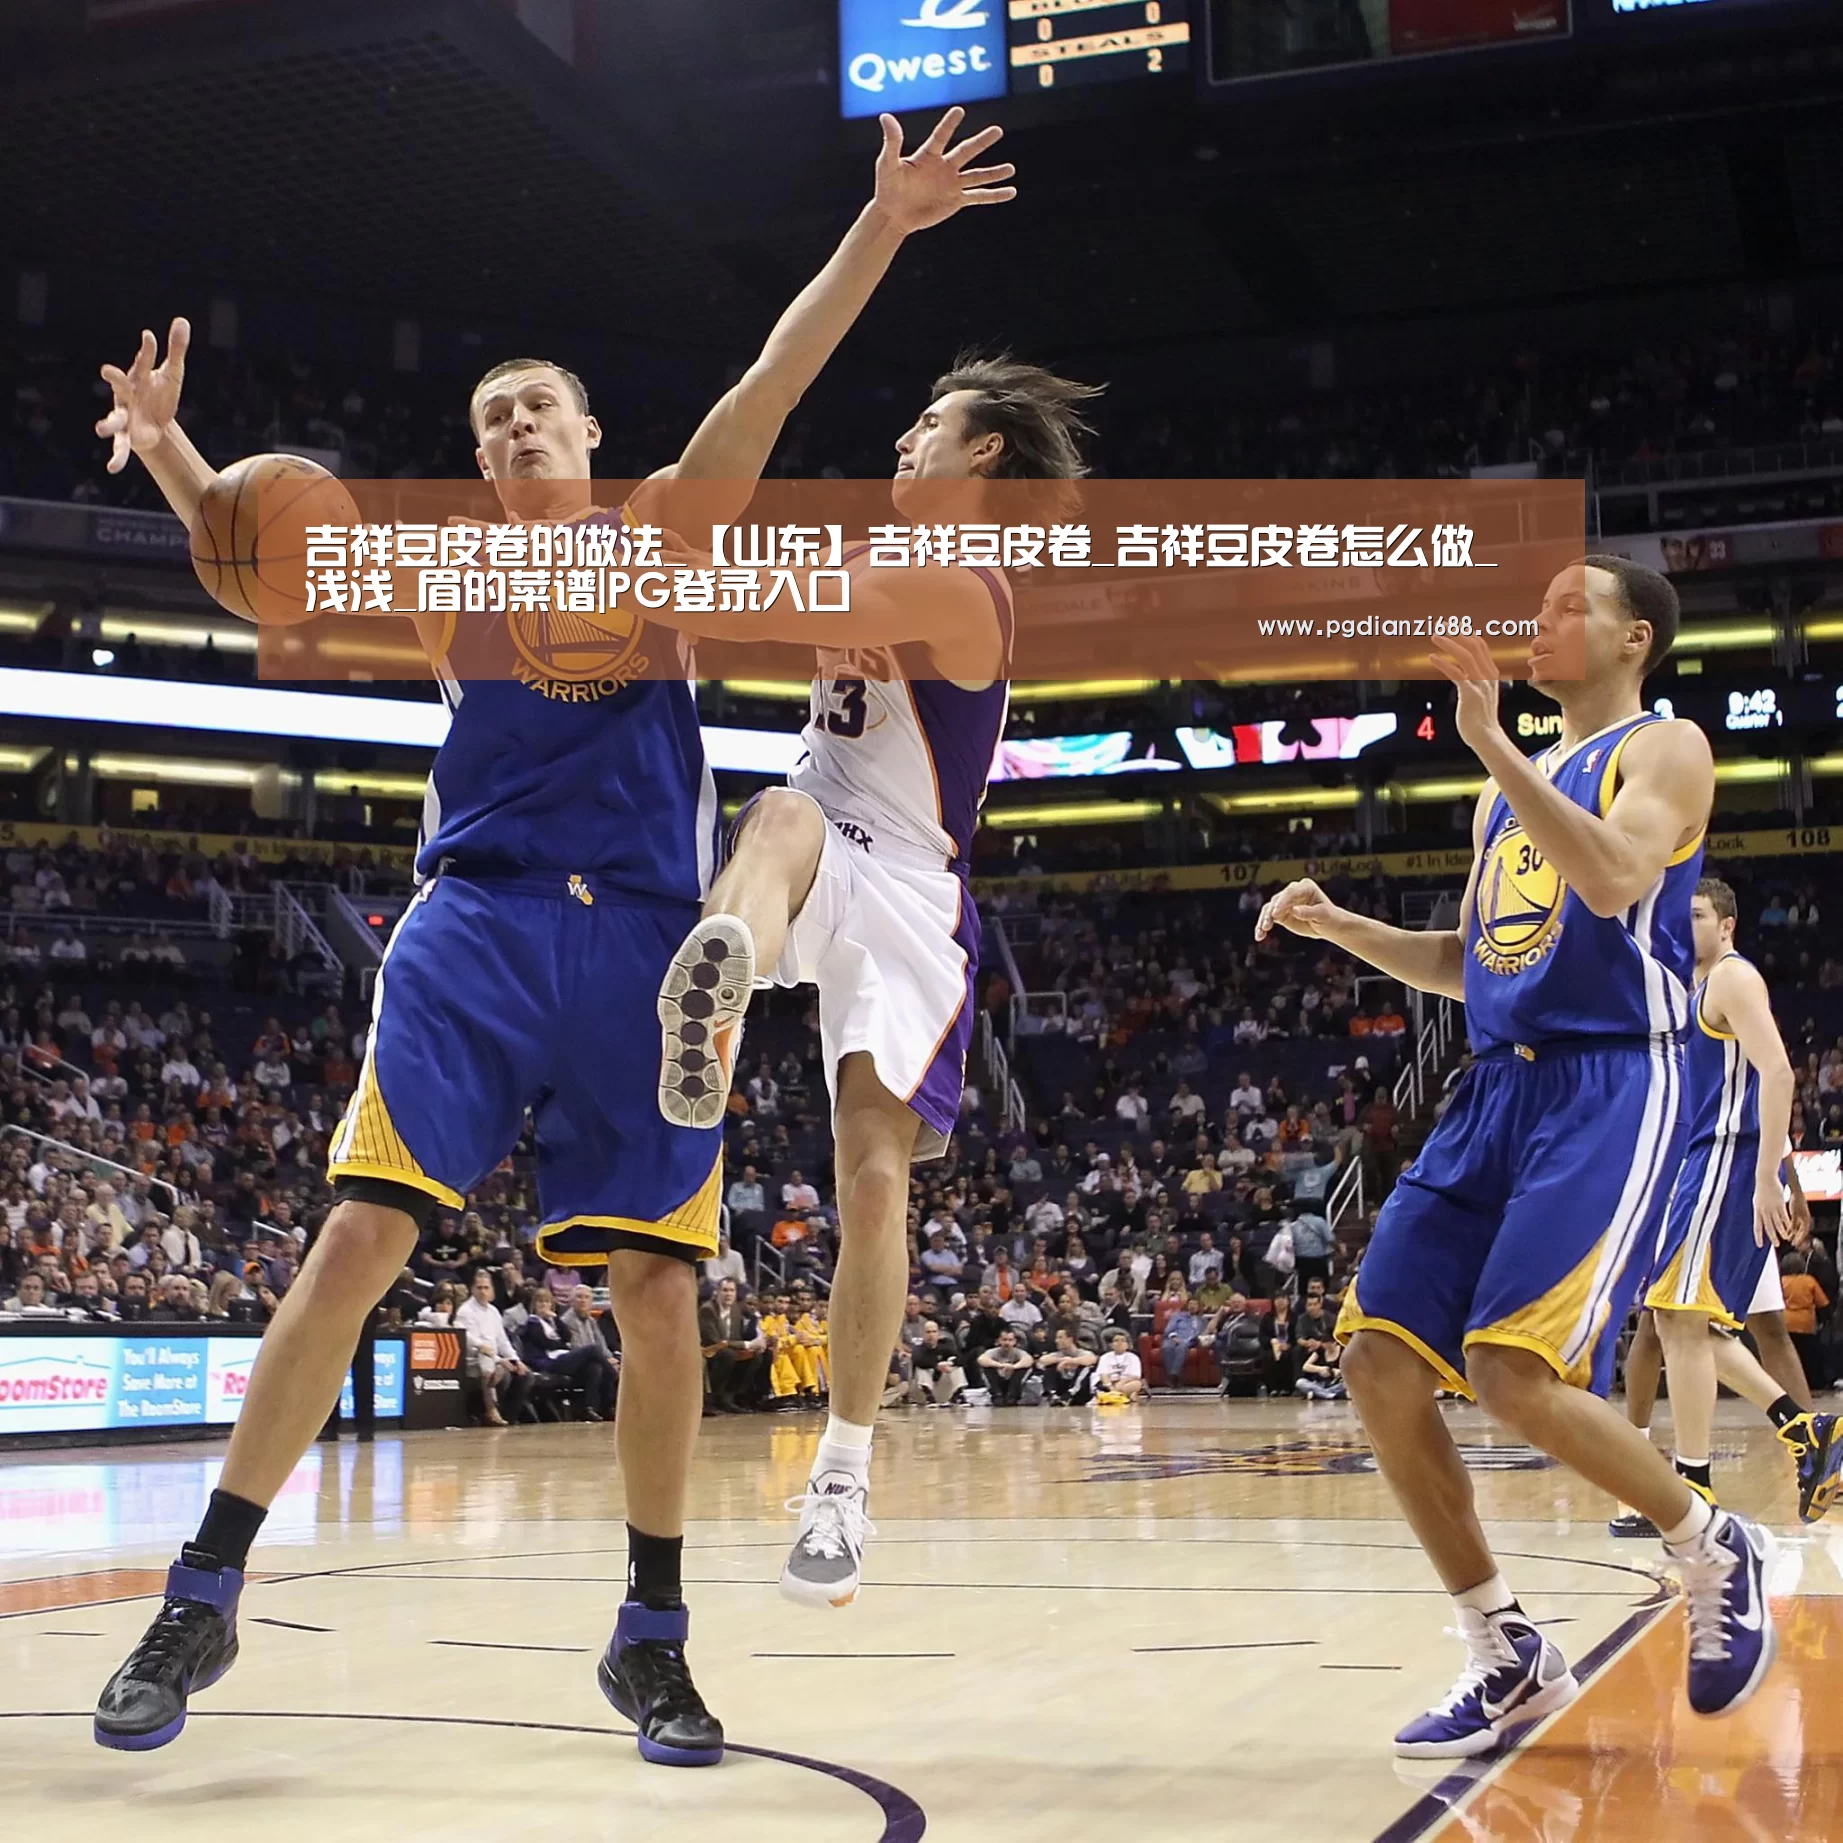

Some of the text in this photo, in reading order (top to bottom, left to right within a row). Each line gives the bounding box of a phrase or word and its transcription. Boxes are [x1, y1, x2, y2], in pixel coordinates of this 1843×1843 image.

[1037, 2, 1161, 42] 0 0
[1031, 31, 1165, 58] STEALS
[848, 44, 991, 93] Qwest
[1039, 48, 1163, 87] 0 2
[97, 527, 189, 549] CHAMP
[511, 652, 650, 703] WARRIORS
[1416, 716, 1435, 741] 4
[1517, 712, 1563, 737] Sun
[1706, 828, 1831, 850] Lock 108
[1220, 864, 1260, 882] 107
[157, 1347, 200, 1369] Always
[0, 1374, 108, 1402] oomStore
[122, 1374, 152, 1392] Save
[153, 1372, 183, 1391] More
[184, 1373, 199, 1390] at
[118, 1399, 202, 1418] The RoomStore
